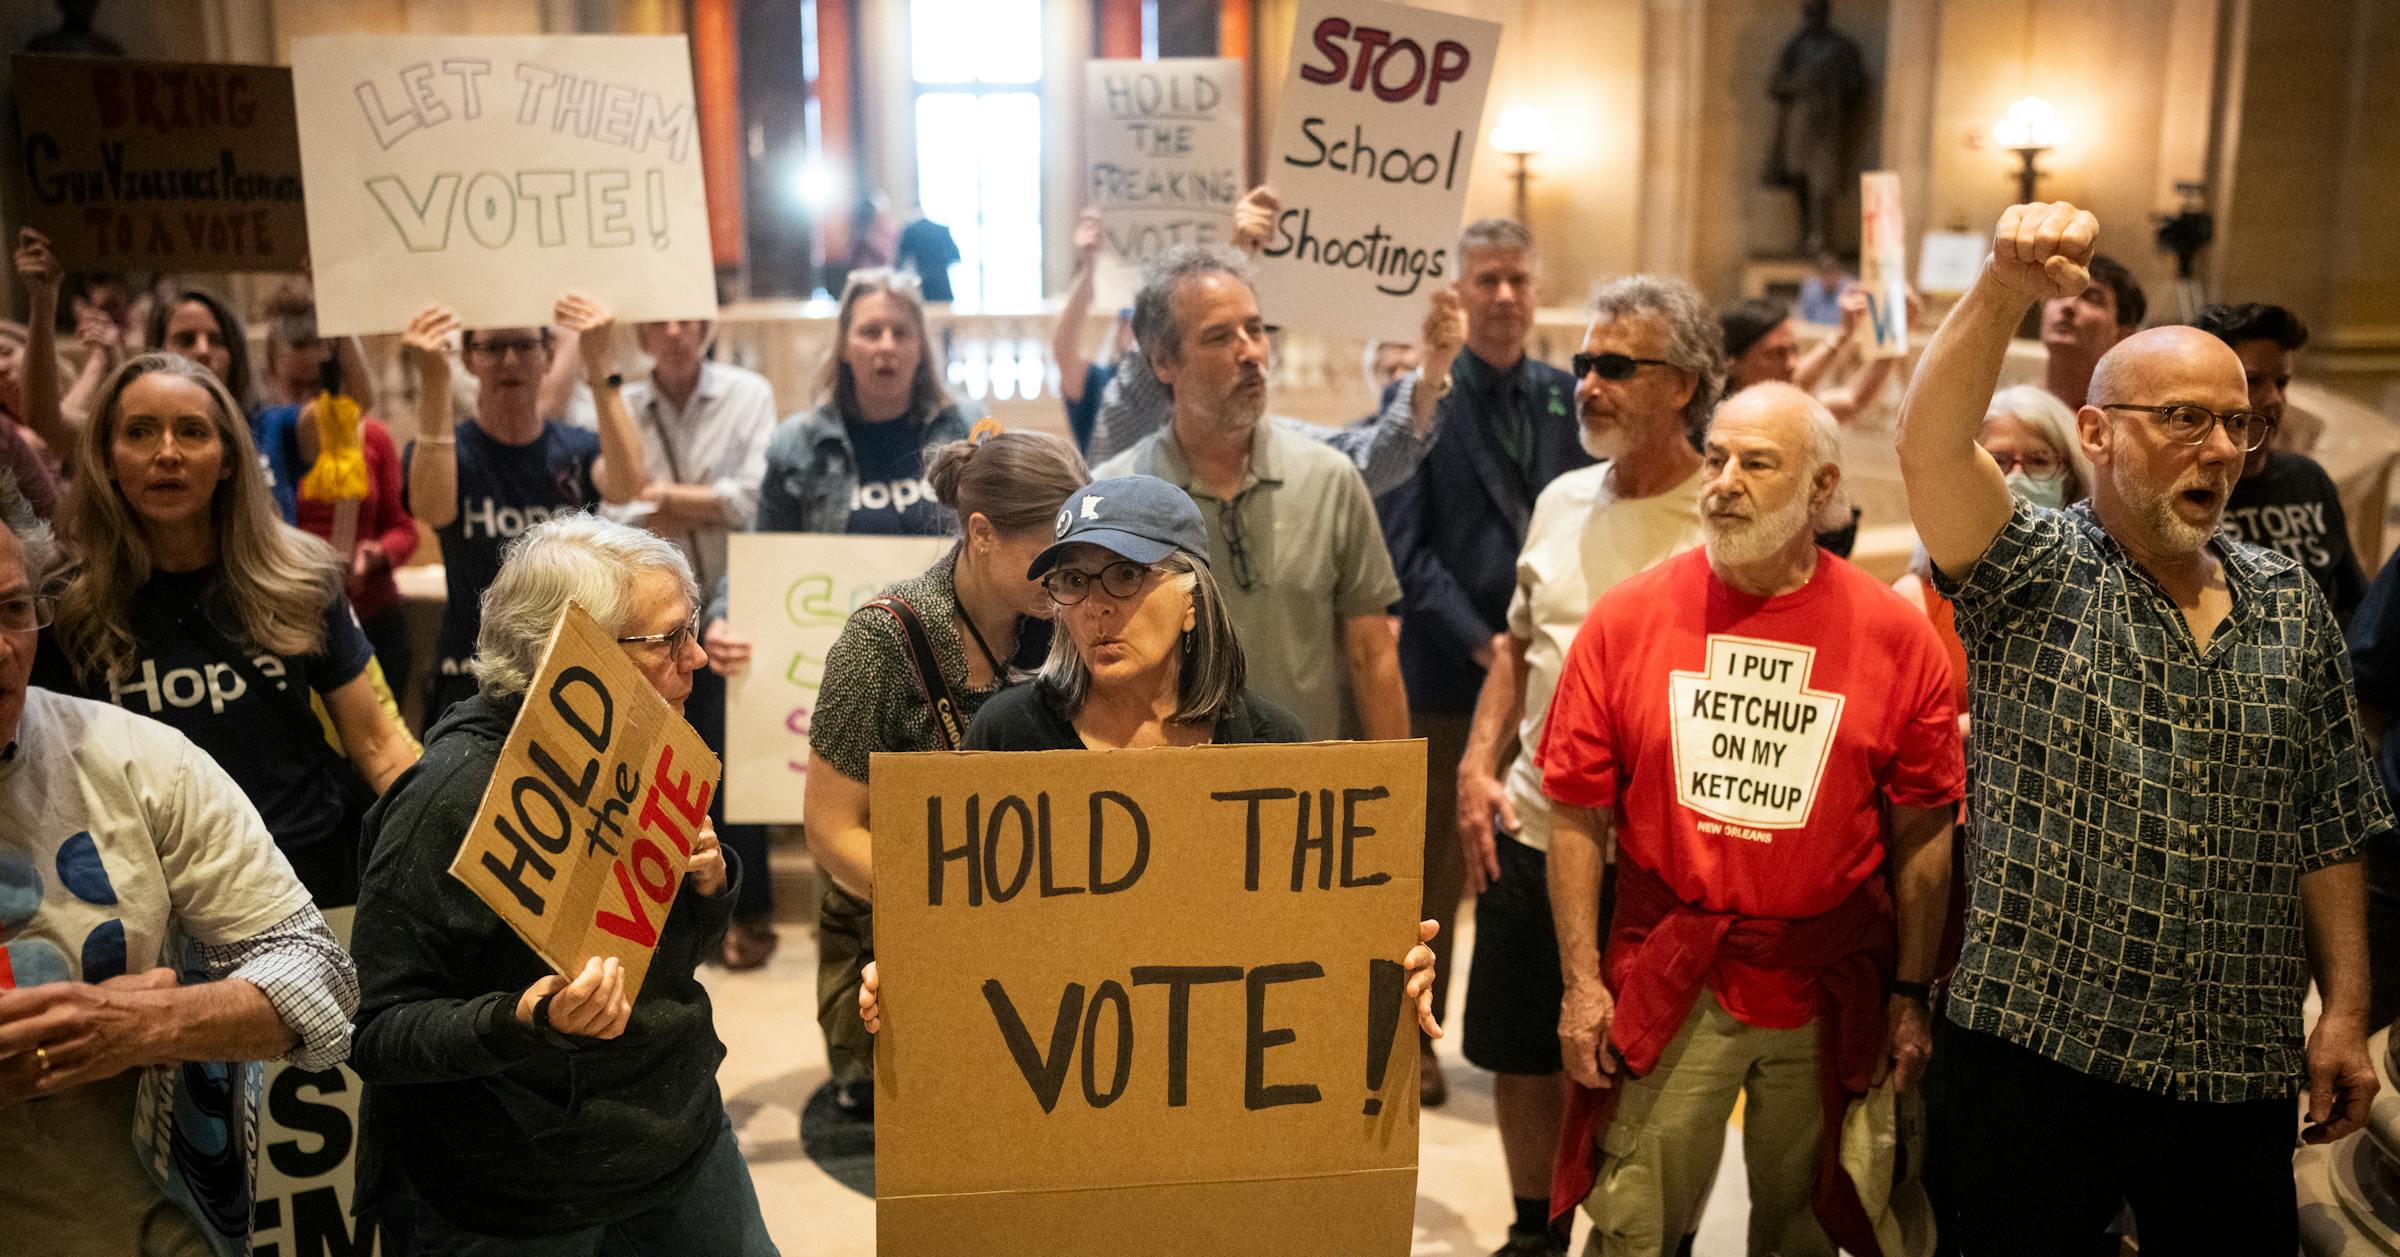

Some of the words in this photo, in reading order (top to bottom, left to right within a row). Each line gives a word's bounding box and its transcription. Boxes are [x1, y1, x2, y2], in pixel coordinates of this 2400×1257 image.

[1301, 17, 1470, 105] STOP
[92, 68, 258, 131] BRING
[355, 58, 491, 150] LET
[516, 62, 696, 163] THEM
[1104, 73, 1221, 115] HOLD
[1127, 123, 1193, 152] THE
[1285, 117, 1462, 191] School
[1094, 162, 1237, 203] FREAKING
[84, 207, 134, 254] TO
[148, 210, 174, 253] A
[184, 207, 275, 255] VOTE
[365, 169, 670, 253] VOTE!
[1104, 219, 1217, 263] VOTE
[1263, 208, 1446, 296] Shootings
[1728, 653, 1736, 676] I
[1743, 655, 1794, 683] PUT
[1692, 689, 1818, 735] KETCHUP
[1712, 733, 1745, 761] ON
[1752, 739, 1788, 768] MY
[481, 665, 613, 917] HOLD
[585, 761, 640, 858] the
[1692, 772, 1802, 811] KETCHUP
[595, 744, 711, 948] VOTE
[928, 789, 1151, 907] HOLD
[1211, 785, 1392, 892] THE
[1697, 821, 1722, 834] NEW
[1724, 827, 1773, 843] ORLEANS
